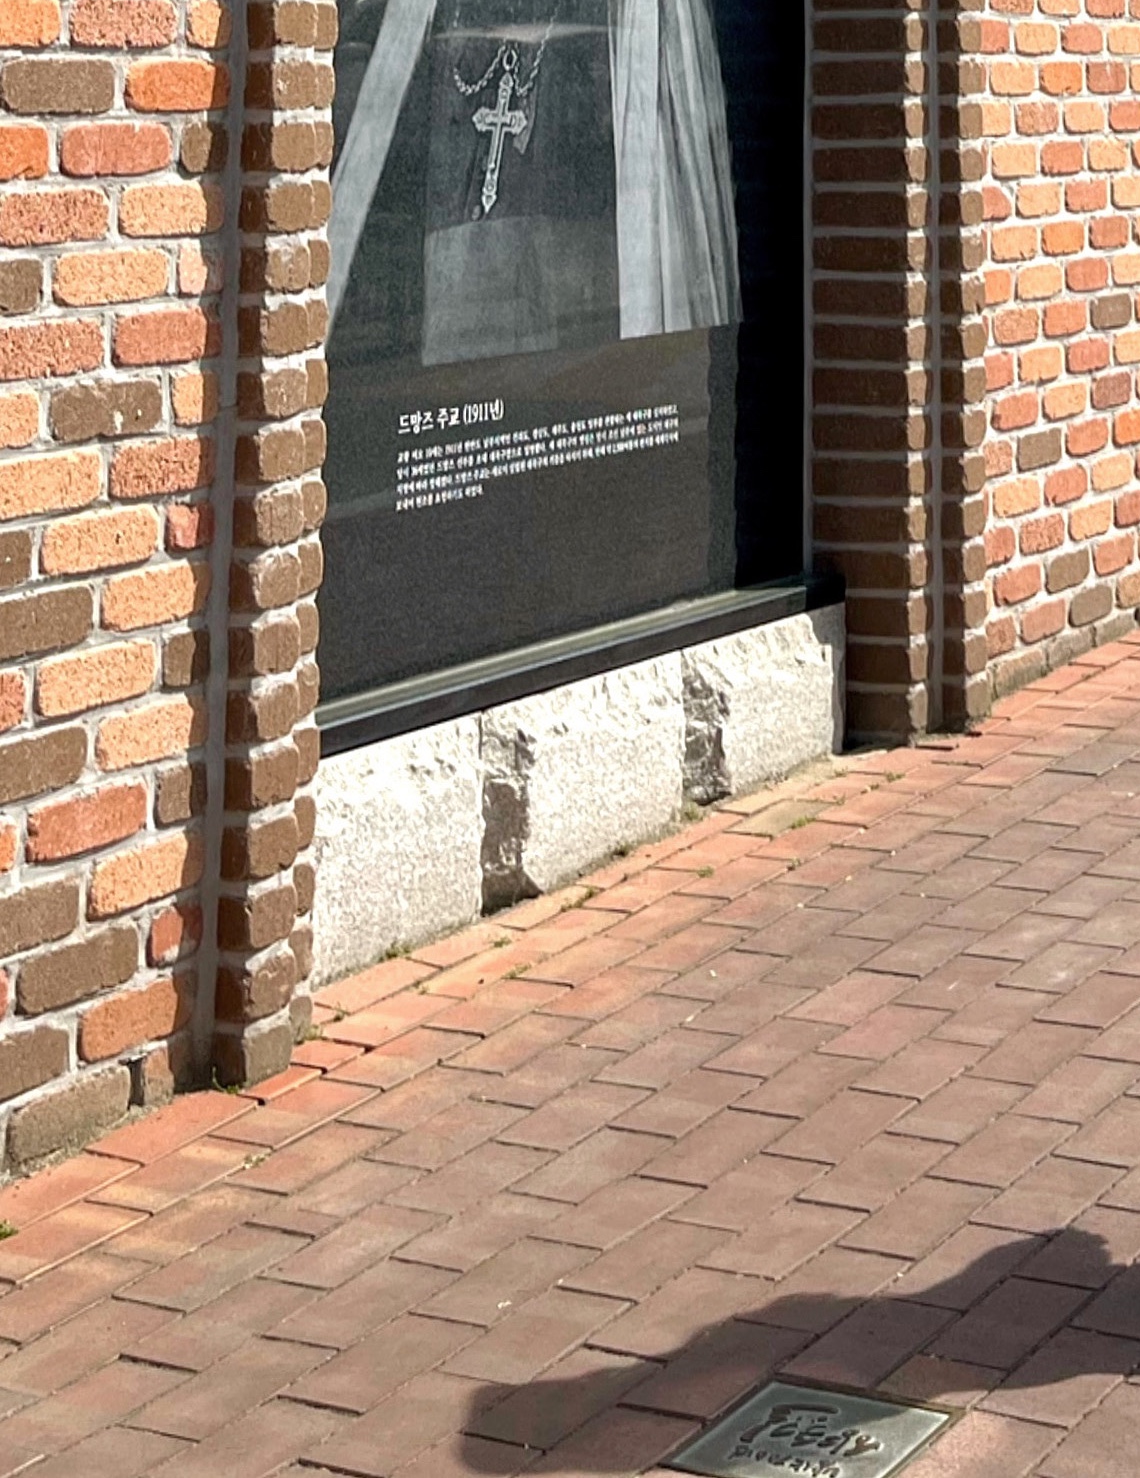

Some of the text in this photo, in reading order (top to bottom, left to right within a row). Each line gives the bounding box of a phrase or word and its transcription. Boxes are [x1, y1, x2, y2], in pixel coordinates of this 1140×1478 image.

[398, 399, 504, 434] 드망즈 주교 (1911년)
